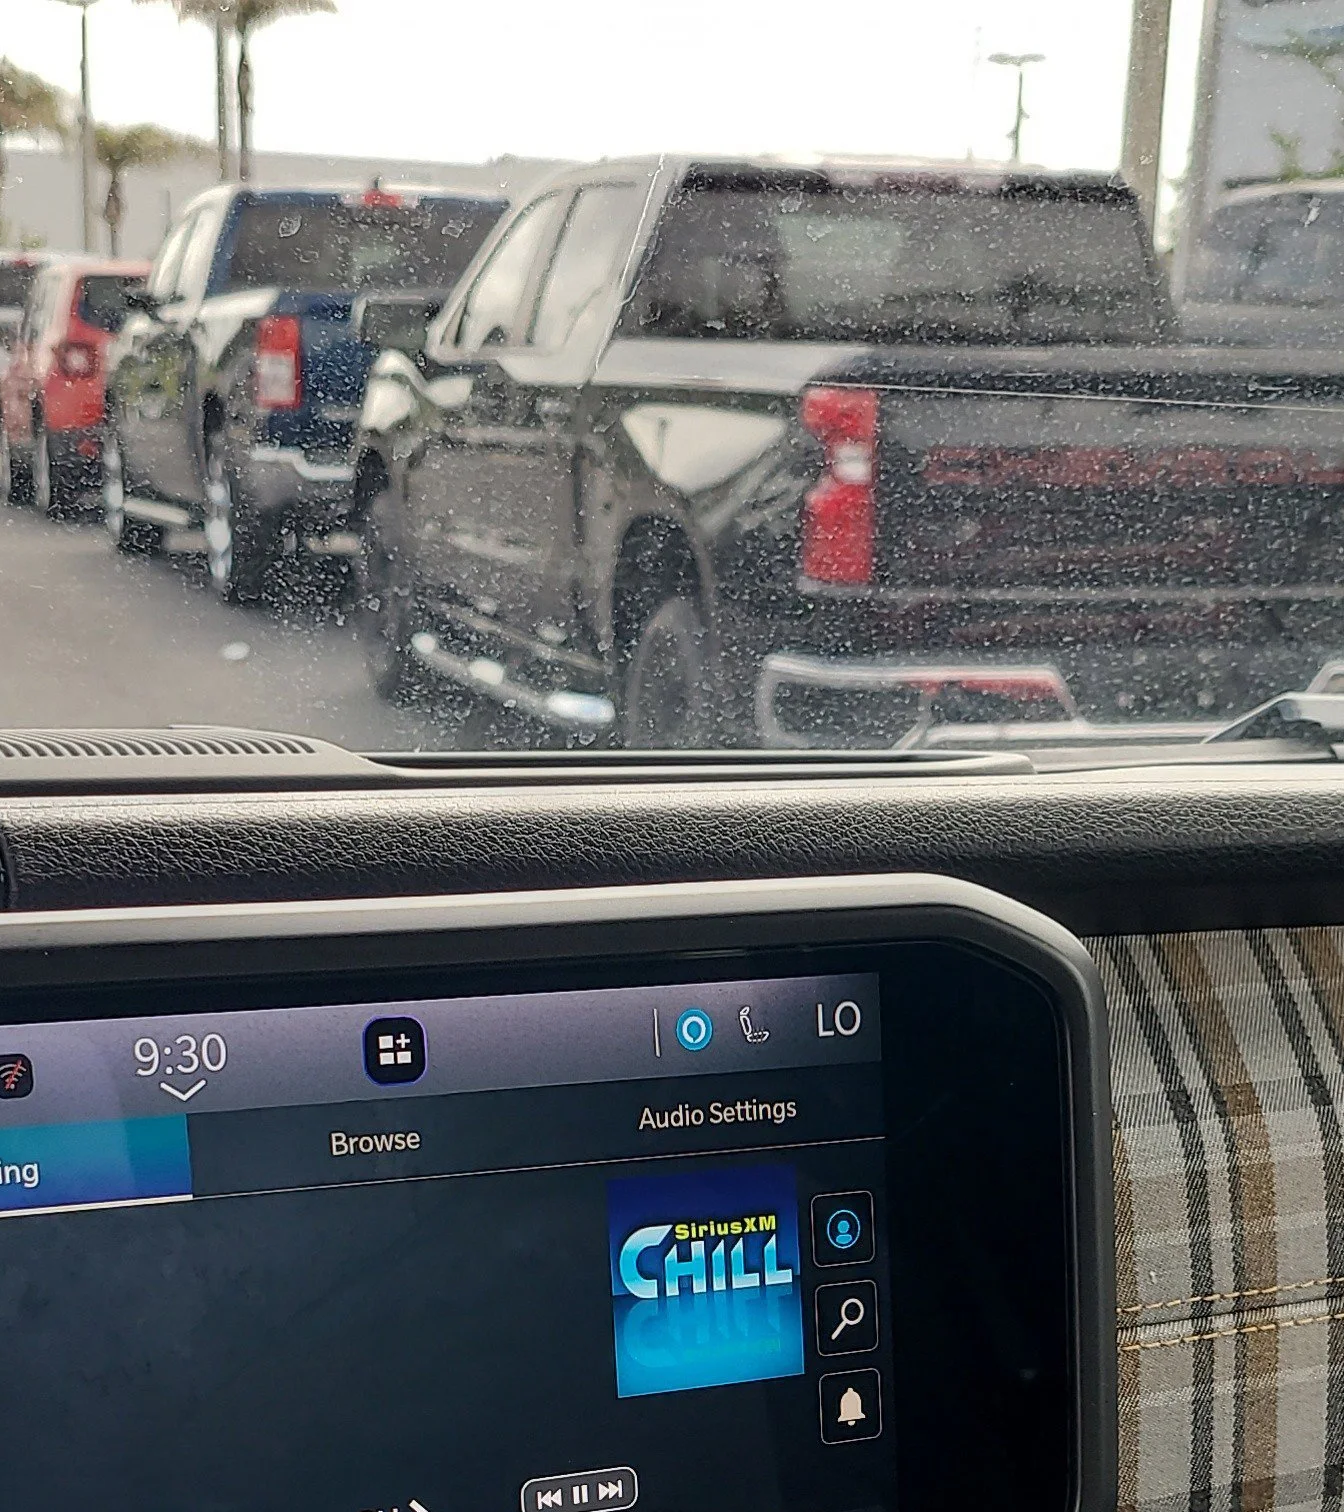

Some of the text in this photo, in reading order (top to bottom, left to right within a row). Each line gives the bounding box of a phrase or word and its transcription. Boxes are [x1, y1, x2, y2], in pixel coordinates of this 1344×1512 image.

[816, 1001, 861, 1038] LO
[133, 1033, 227, 1077] 9:30
[638, 1099, 797, 1131] Audio Settings
[330, 1129, 421, 1157] Browse
[674, 1215, 776, 1240] SiriusXM
[619, 1223, 793, 1298] CHILL
